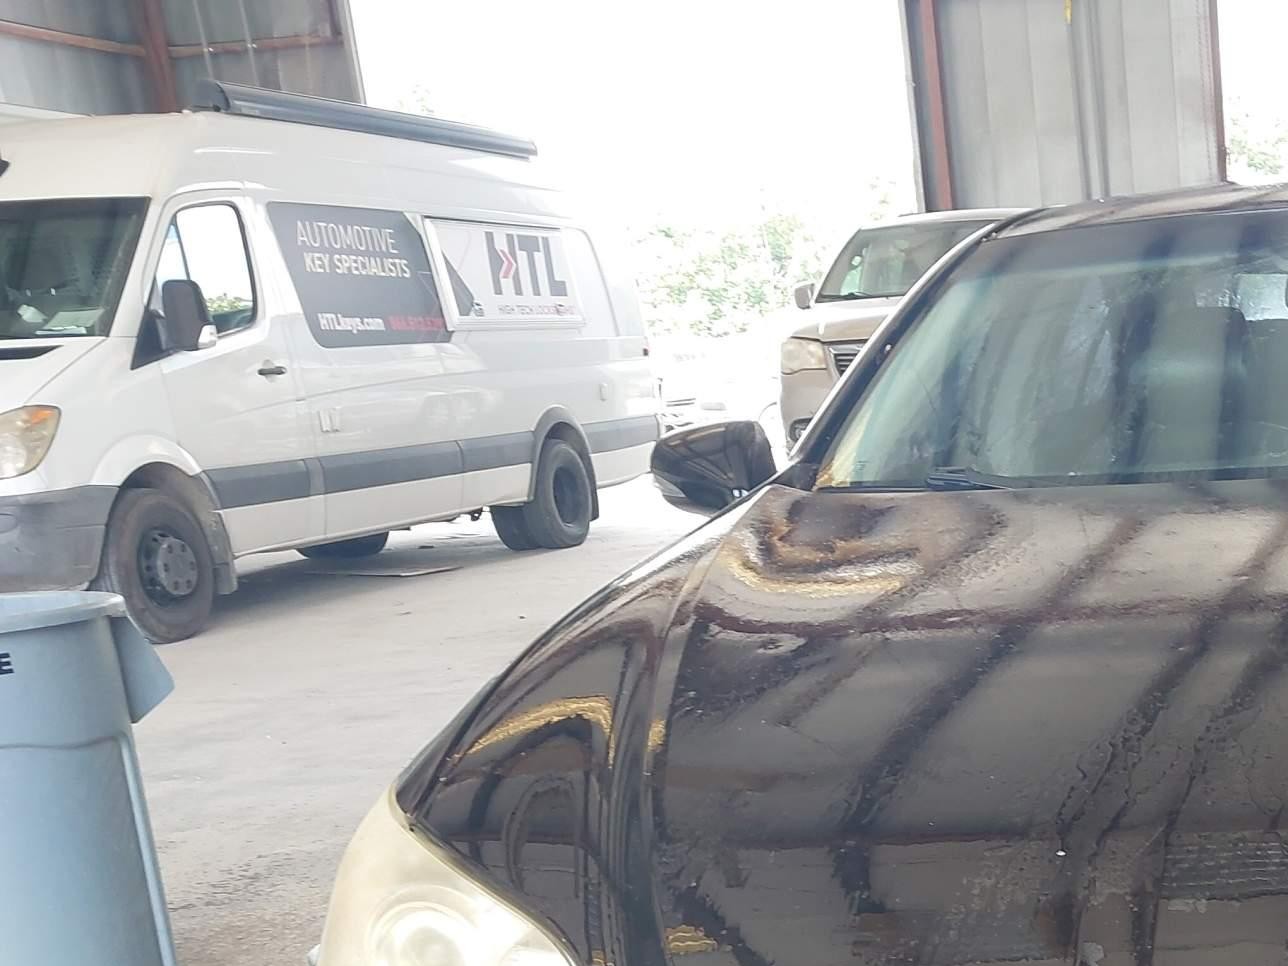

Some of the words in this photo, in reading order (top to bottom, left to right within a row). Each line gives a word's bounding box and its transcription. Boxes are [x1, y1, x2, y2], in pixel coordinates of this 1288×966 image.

[297, 221, 399, 253] AUTOMOTIVE
[304, 252, 330, 272] KEY
[333, 255, 411, 278] SPECIALISTS
[484, 230, 568, 297] HTL
